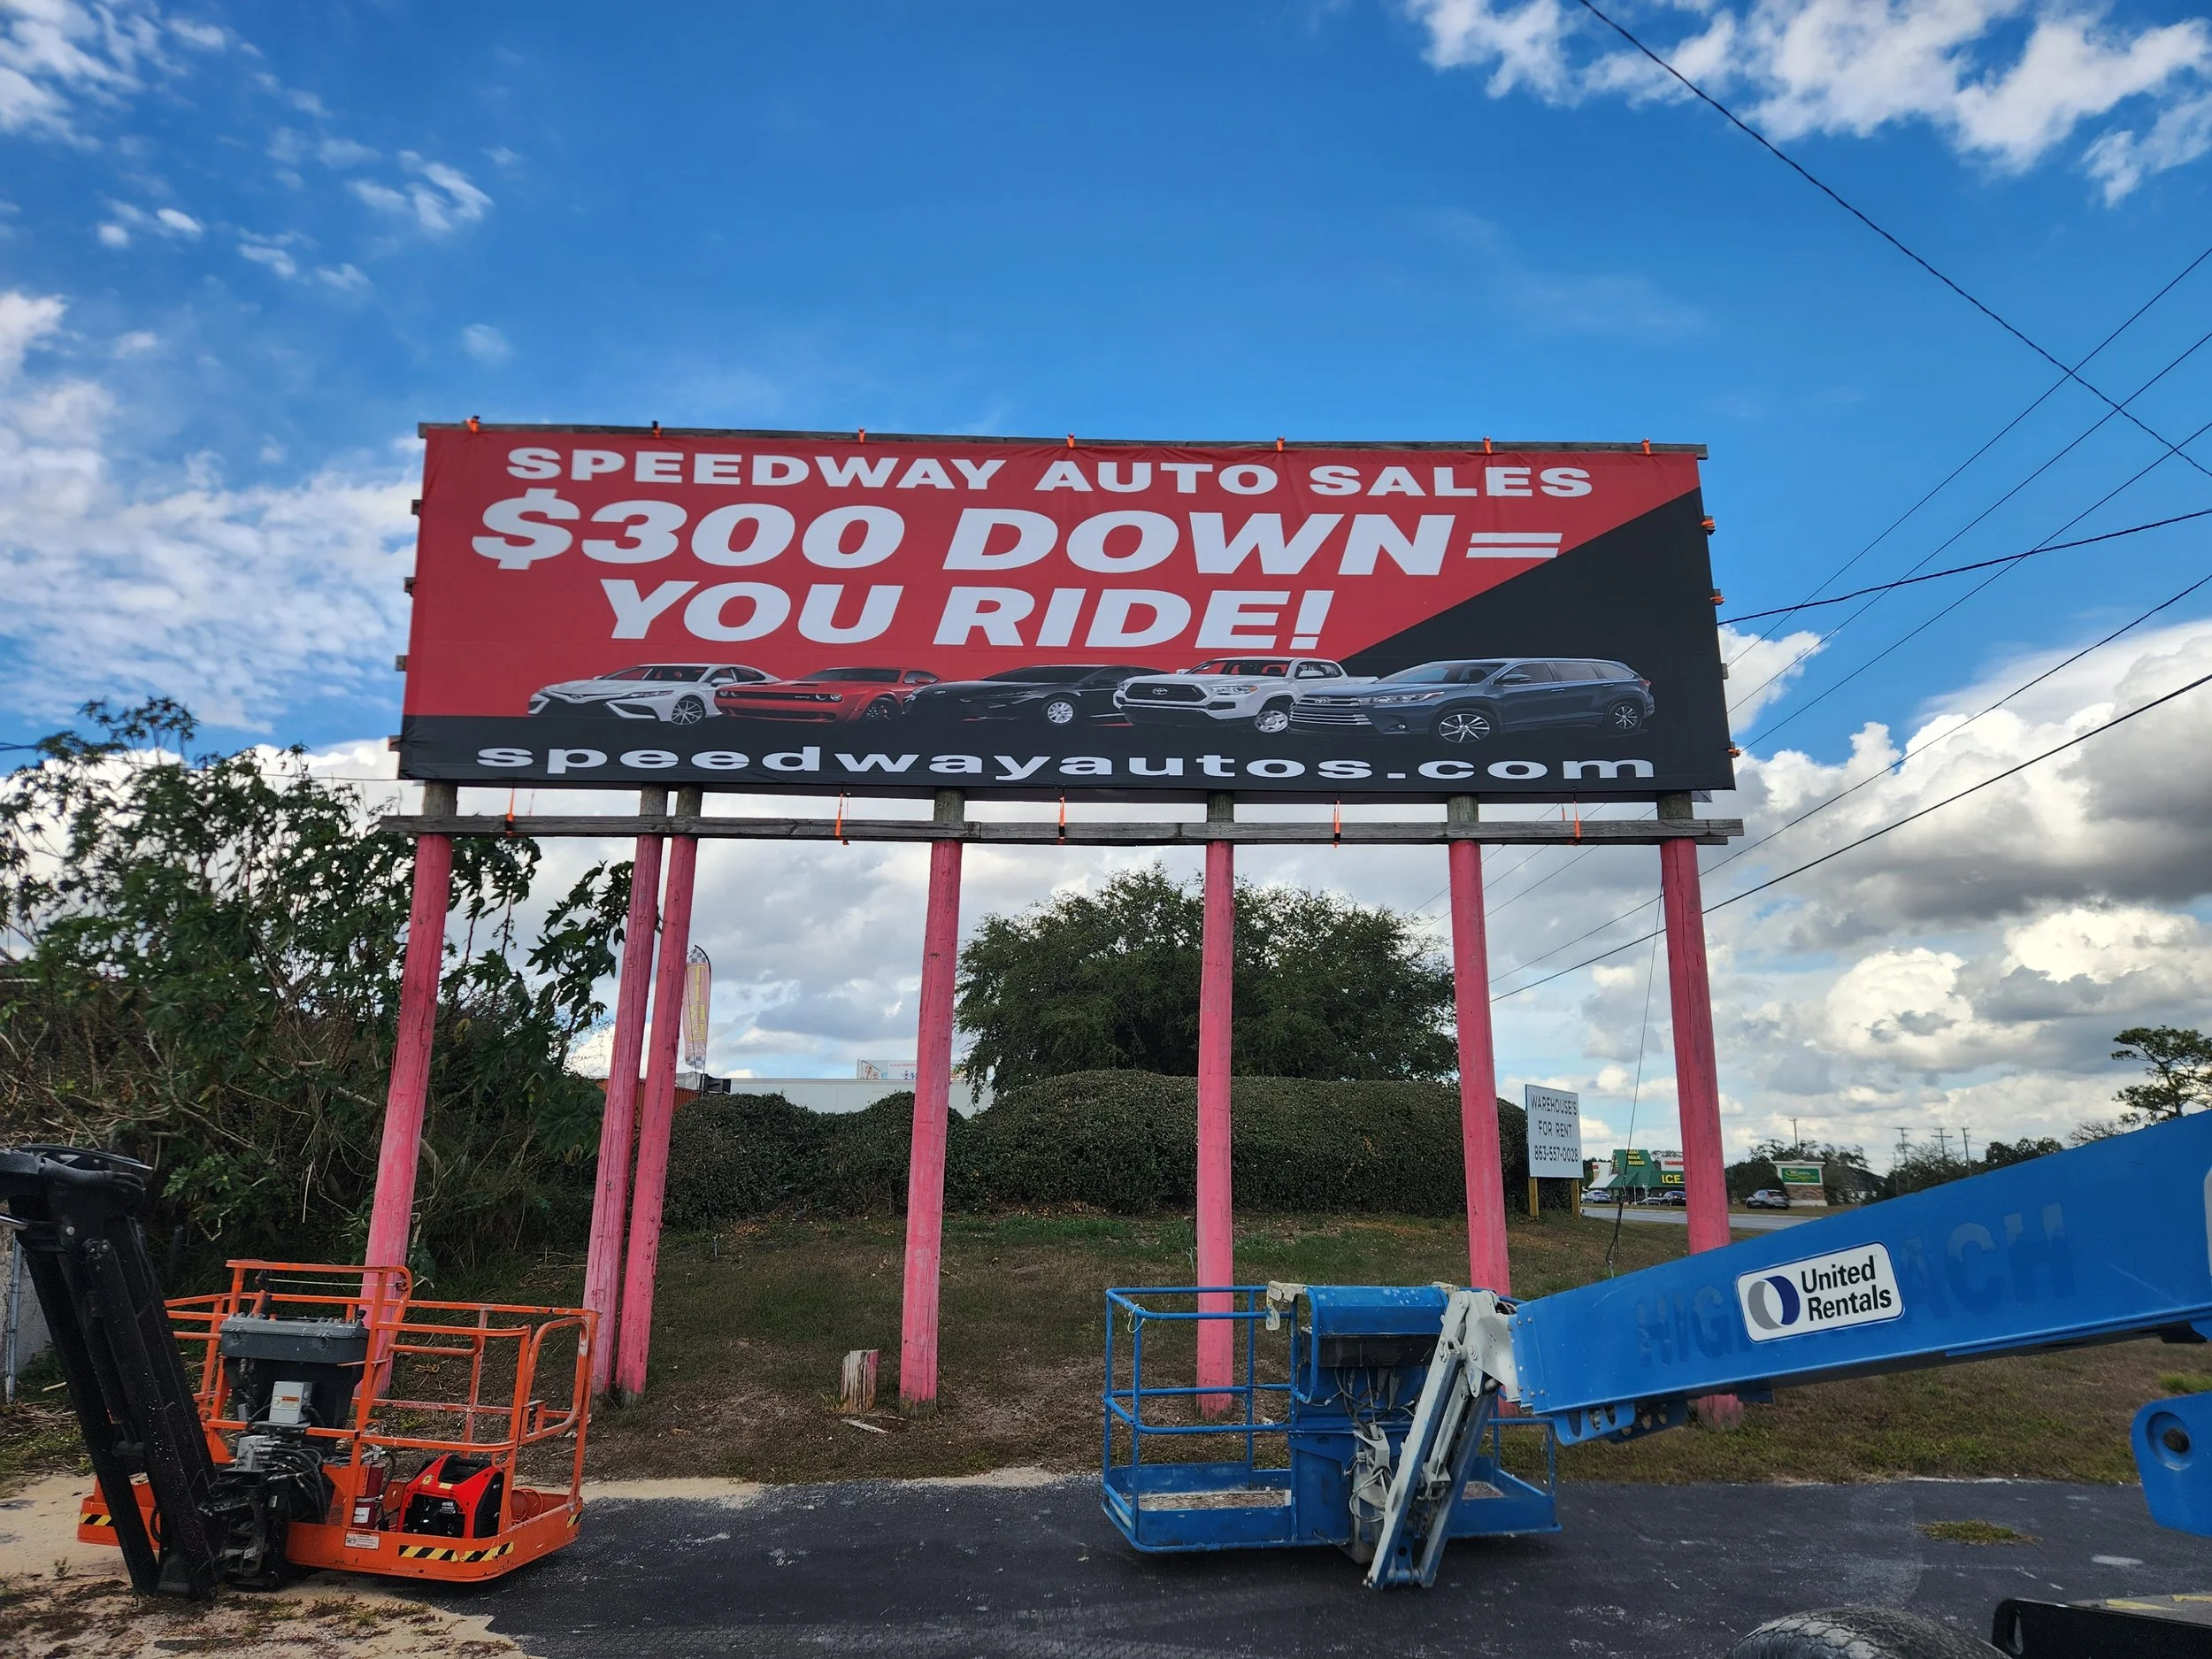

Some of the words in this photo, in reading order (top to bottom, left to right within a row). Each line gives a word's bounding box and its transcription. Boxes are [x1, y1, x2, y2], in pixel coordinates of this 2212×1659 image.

[506, 447, 1006, 490] SPEEDWAY
[1033, 460, 1279, 495] AUTO
[1309, 465, 1593, 498] SALES
[472, 488, 905, 571] $300
[942, 507, 1563, 576] DOWN=
[600, 579, 904, 644] YOU
[933, 586, 1335, 650] RIDE!
[476, 746, 1655, 781] speedwayautos.com
[1531, 1094, 1577, 1115] WAREHOUSE'S
[1539, 1120, 1553, 1136] FOR
[1555, 1123, 1571, 1138] RENT
[1662, 1174, 1681, 1184] ICE
[1801, 1255, 1876, 1294] United
[1808, 1284, 1892, 1321] Rentals
